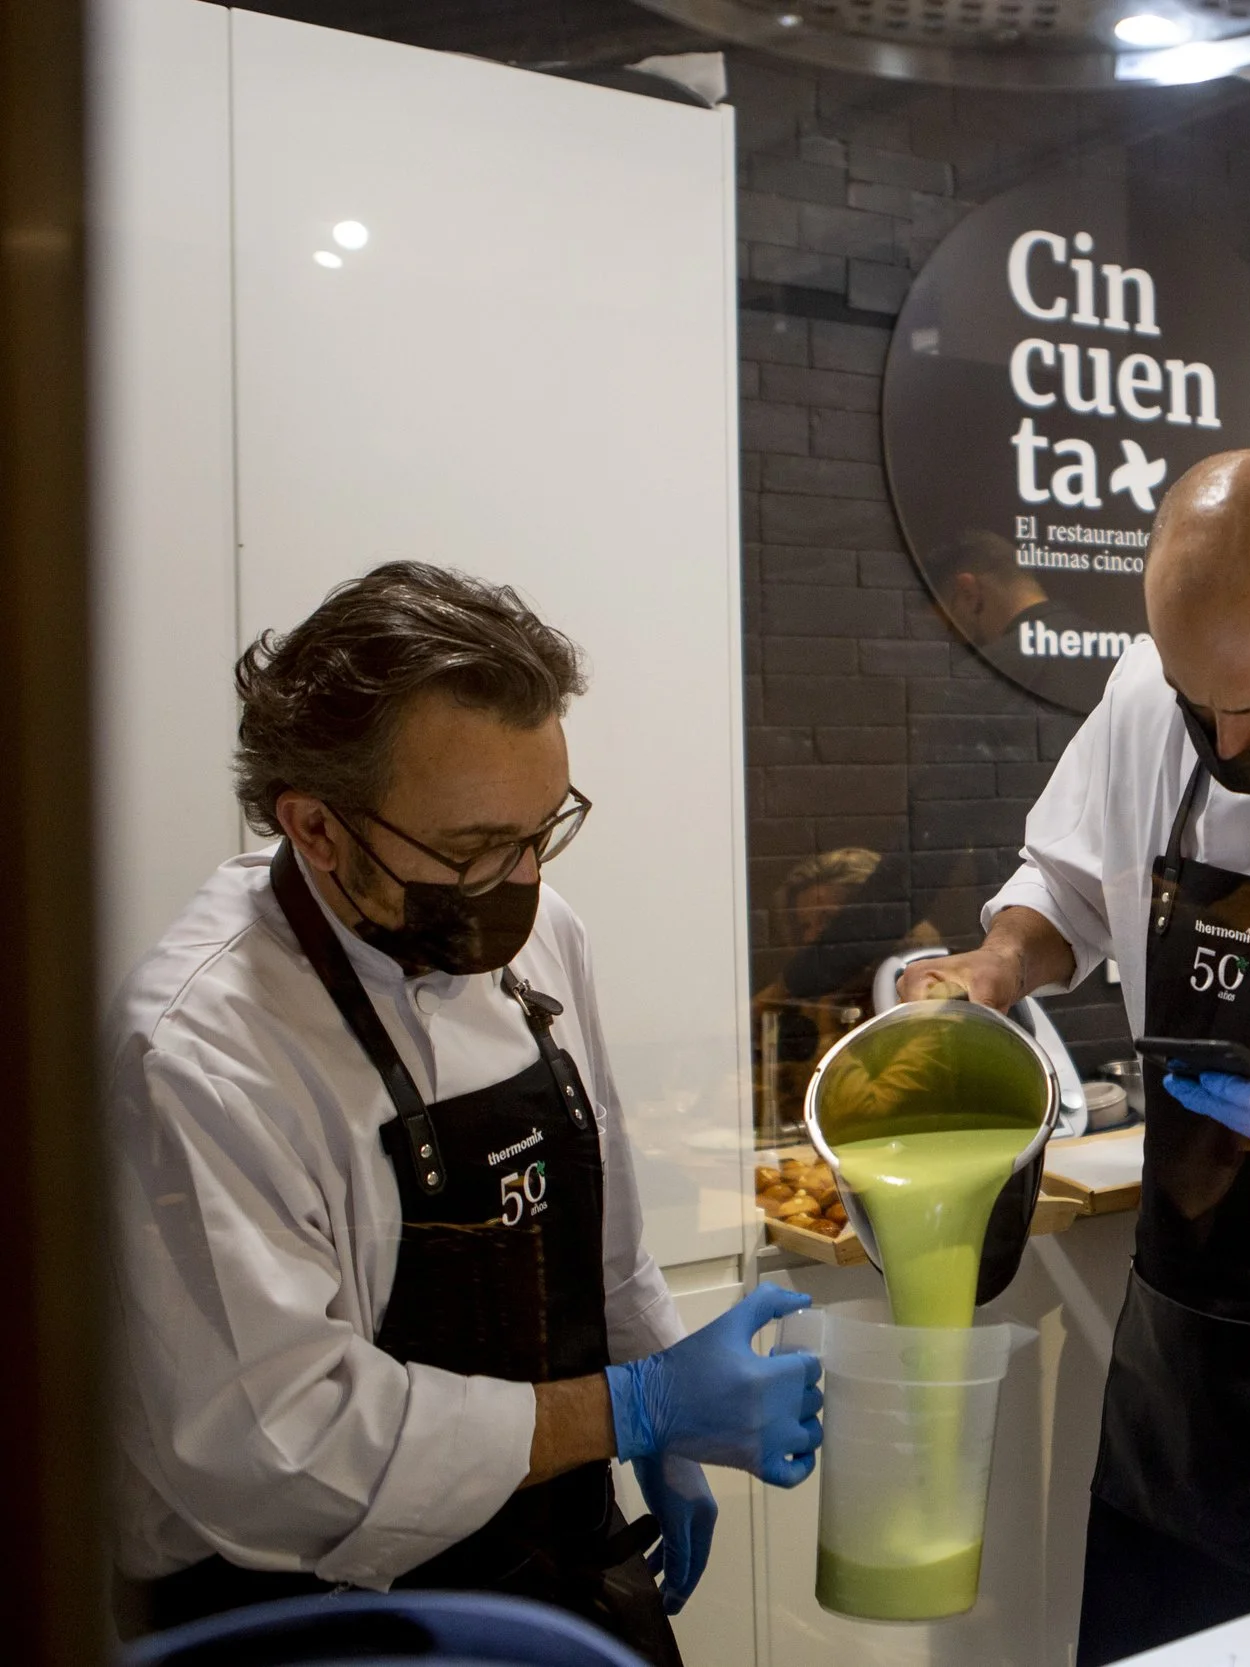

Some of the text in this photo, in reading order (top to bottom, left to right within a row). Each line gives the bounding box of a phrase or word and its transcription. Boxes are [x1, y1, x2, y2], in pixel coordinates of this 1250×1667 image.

[1007, 229, 1160, 336] Cin
[1010, 337, 1221, 428] cuen
[1010, 417, 1102, 509] ta
[1015, 515, 1037, 539] El
[1017, 543, 1144, 572] últimas cinco
[1019, 620, 1153, 658] therm
[1190, 946, 1245, 992] 50
[487, 1127, 544, 1166] thermomix
[501, 1162, 546, 1226] 50
